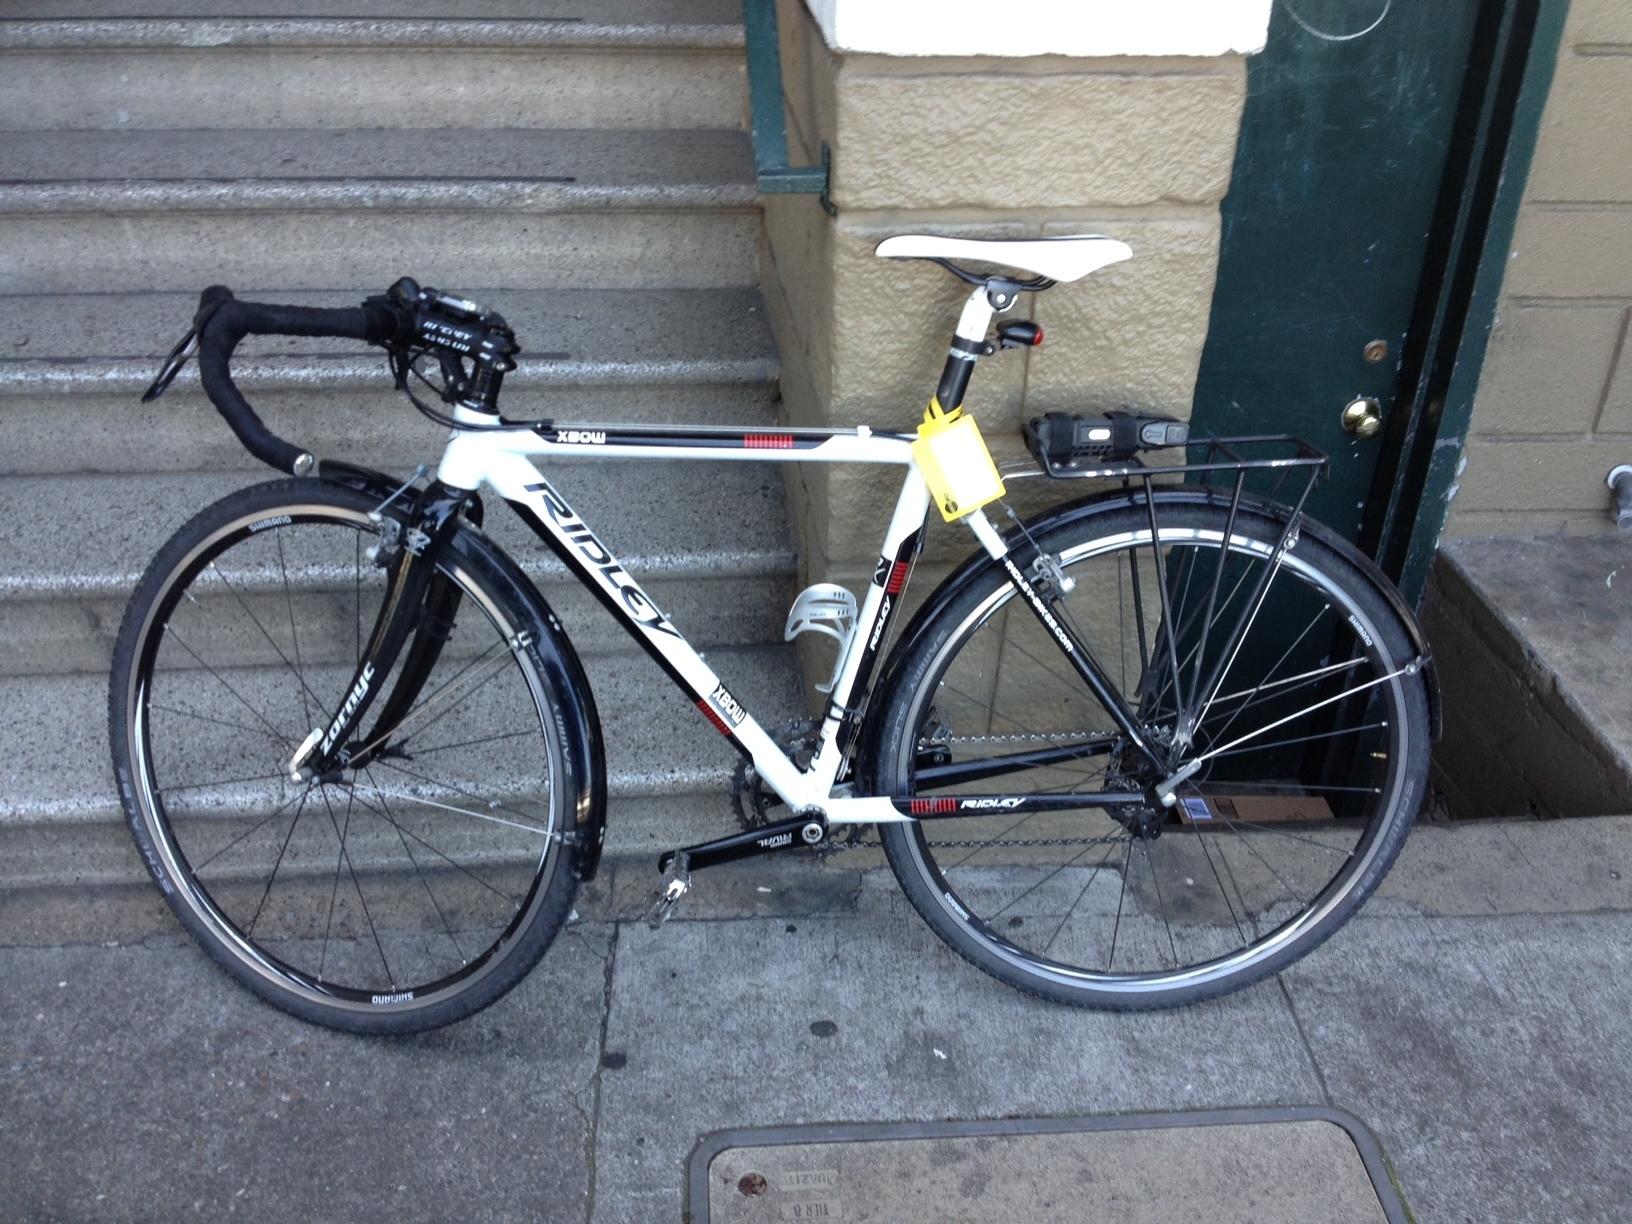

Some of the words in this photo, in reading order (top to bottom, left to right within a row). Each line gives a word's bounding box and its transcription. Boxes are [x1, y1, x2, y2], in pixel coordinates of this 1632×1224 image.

[557, 430, 606, 444] XBOW
[248, 514, 292, 533] SHIMANO
[523, 482, 683, 641] RIDLEY
[869, 594, 891, 652] RIDLEY
[1347, 614, 1373, 647] SHIMANO
[320, 662, 375, 756] zornyc
[713, 683, 747, 726] XBOW
[960, 797, 1027, 810] RIDLEY
[371, 992, 414, 1004] SHIMANO
